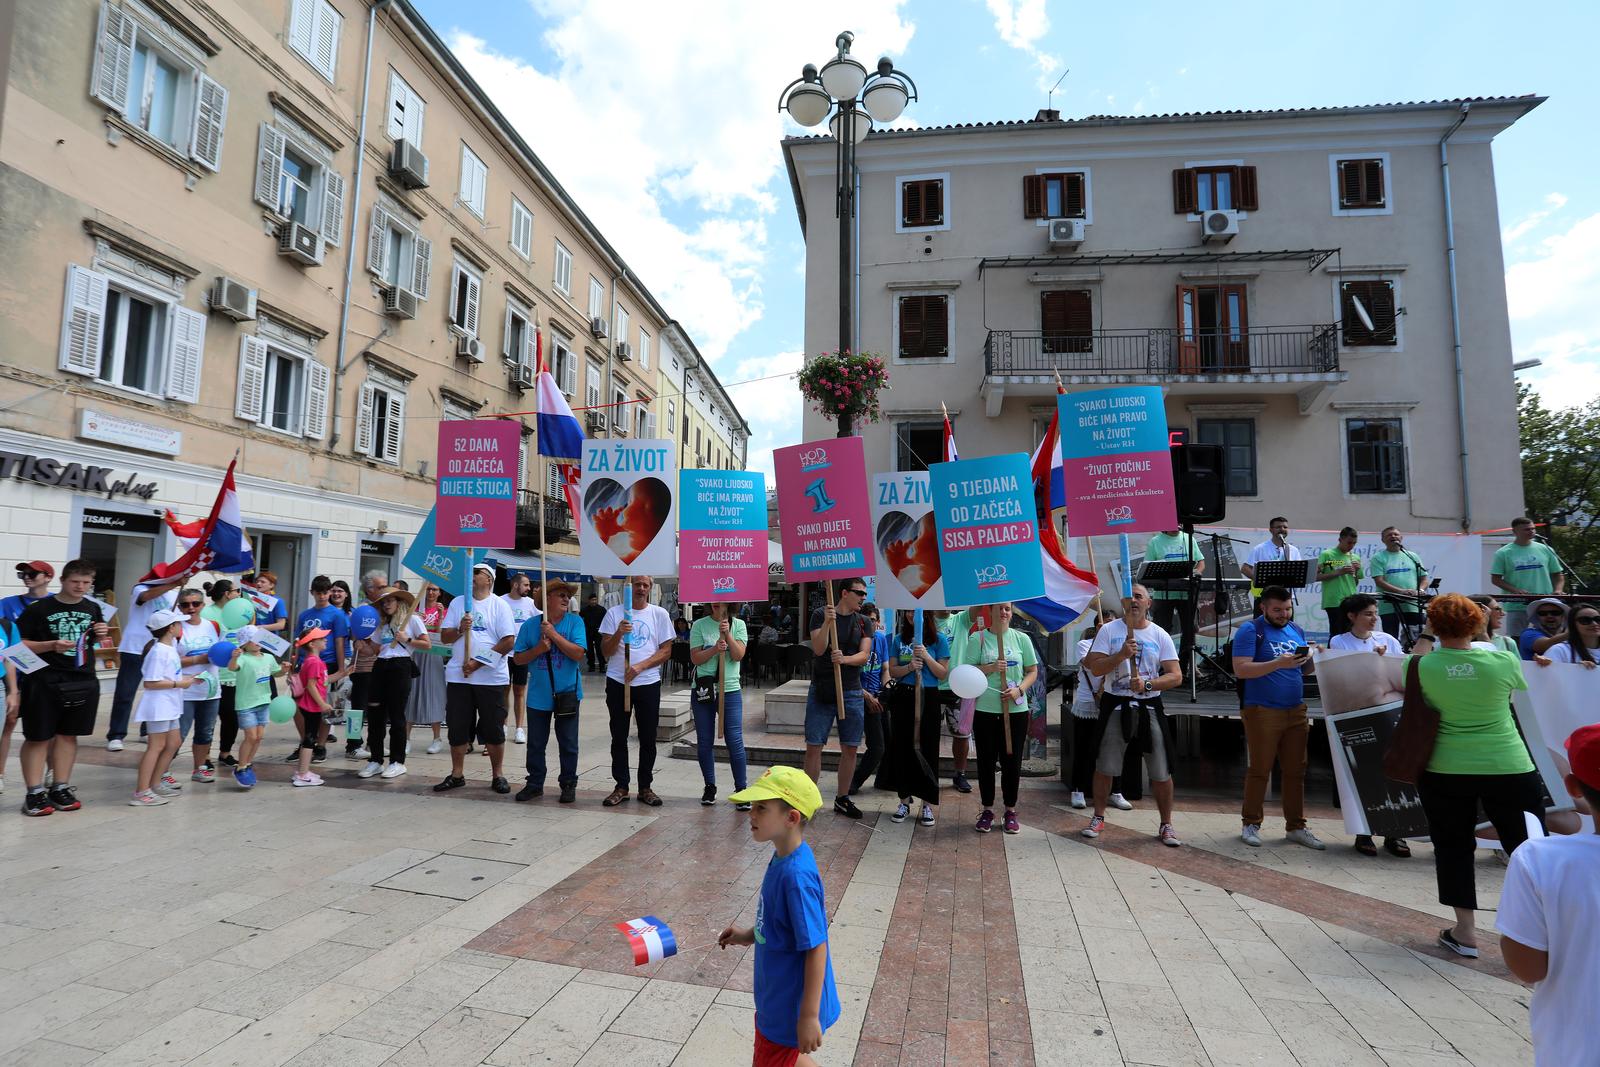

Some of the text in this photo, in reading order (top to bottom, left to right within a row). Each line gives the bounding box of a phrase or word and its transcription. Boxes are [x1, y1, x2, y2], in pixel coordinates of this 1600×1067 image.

[1109, 396, 1146, 408] LJUDSKO
[1101, 413, 1118, 425] IMA
[1120, 411, 1147, 422] PRAVO
[1093, 430, 1105, 441] NA
[454, 438, 499, 452] 52 DANA
[1122, 440, 1135, 448] RH
[588, 444, 668, 472] ZA ŽIVOT
[800, 448, 826, 464] HOD
[448, 457, 504, 473] OD ZAČEĆA
[1115, 460, 1151, 473] POČINJE
[0, 451, 159, 499] TISAK plus
[442, 479, 511, 495] DIJETE ŠTUCA
[879, 477, 932, 505] ZA ŽIV
[950, 475, 1018, 499] 9 TJEDANA
[716, 492, 730, 502] IMA
[732, 493, 754, 503] PRAVO
[1097, 490, 1134, 499] medicinska
[708, 507, 719, 516] NA
[951, 498, 1022, 523] OD ZAČEĆA
[1104, 505, 1132, 518] HOD
[83, 514, 126, 526] TISAK plus
[459, 513, 483, 525] HOD
[797, 519, 852, 536] SVAKO DIJETE
[724, 536, 753, 548] POČINJE
[945, 530, 974, 549] SISA
[978, 525, 1019, 545] PALAC
[804, 537, 847, 552] IMA PRAVO
[426, 550, 453, 572] HOD
[799, 552, 856, 568] NA ROĐENDAN
[974, 564, 1006, 577] HOD
[712, 577, 735, 588] HOD
